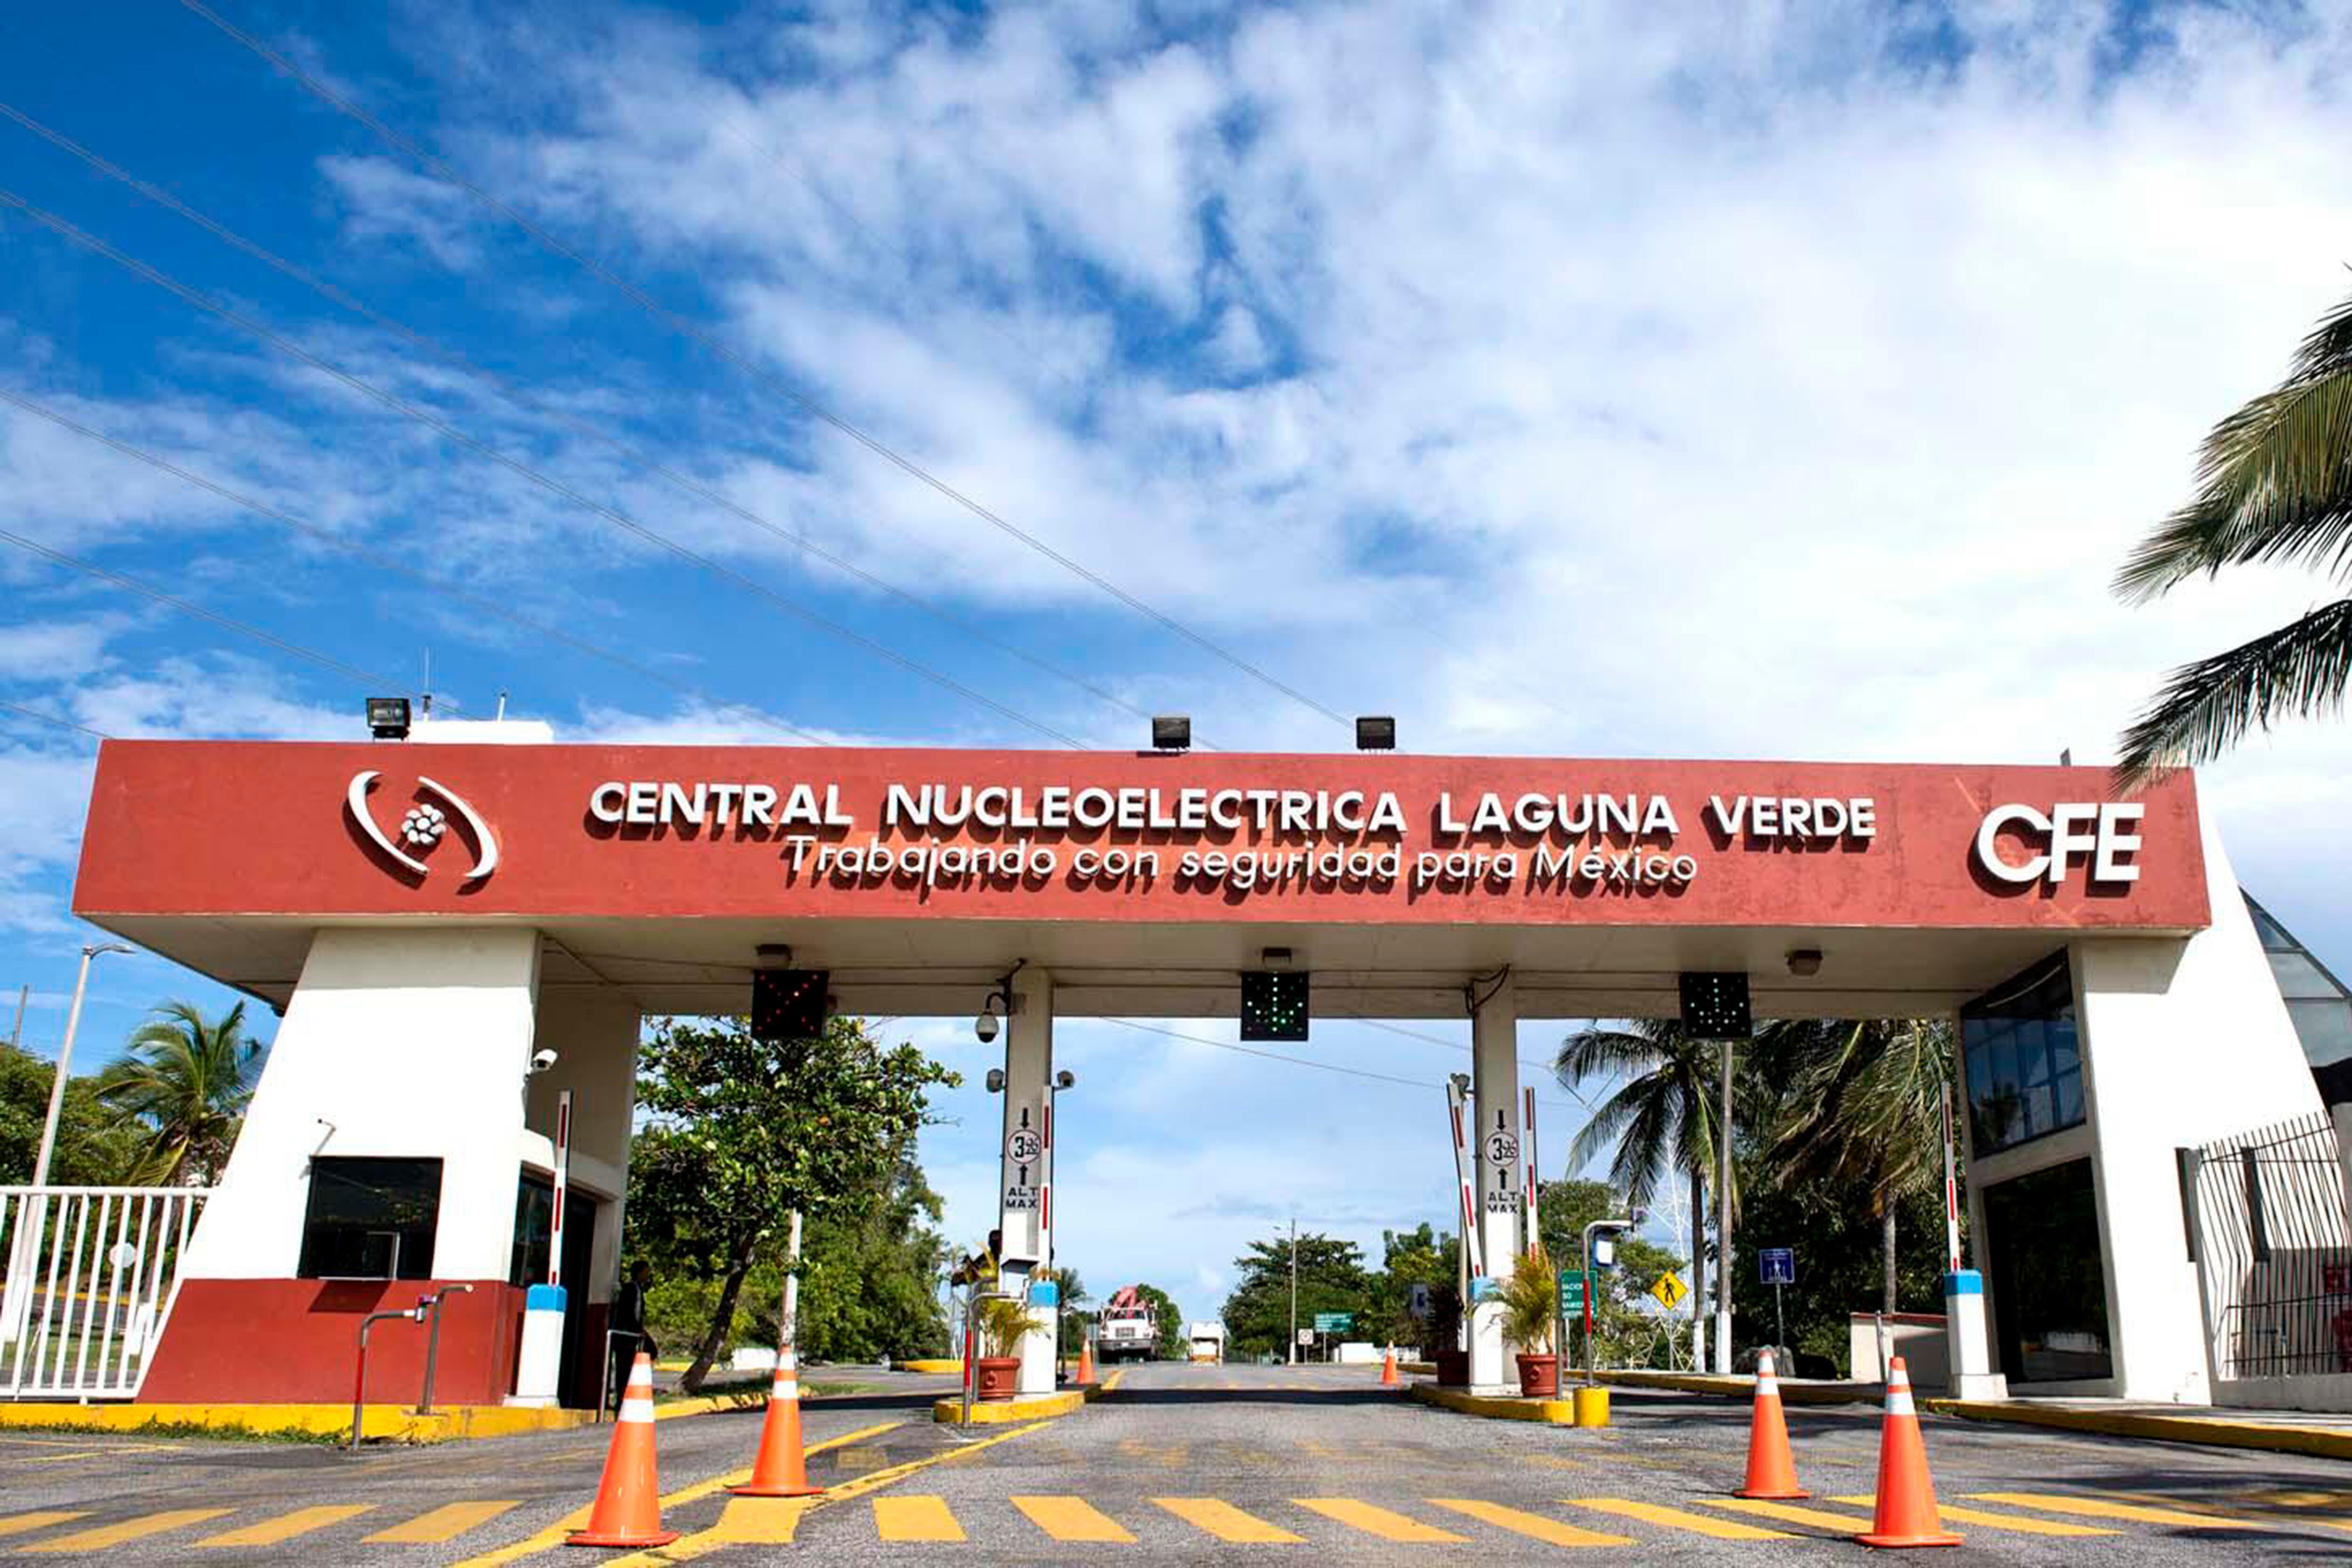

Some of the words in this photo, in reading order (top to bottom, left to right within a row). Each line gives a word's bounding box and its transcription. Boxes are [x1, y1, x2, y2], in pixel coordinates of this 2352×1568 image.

[590, 782, 853, 825] CENTRAL
[887, 784, 1407, 832] NUCLEOELECTRICA
[1440, 792, 1680, 834] LAGUNA
[1710, 796, 1876, 837] VERDE
[1978, 803, 2145, 882] CFE
[787, 835, 1056, 885] Trabajando
[1074, 848, 1159, 877] con
[1181, 842, 1401, 889] seguridad
[1417, 851, 1517, 887] para
[1535, 843, 1698, 881] México
[1008, 1187, 1038, 1197] ALT
[1488, 1192, 1518, 1202] ALT
[1006, 1199, 1037, 1209] MAX
[1487, 1203, 1518, 1214] MAX
